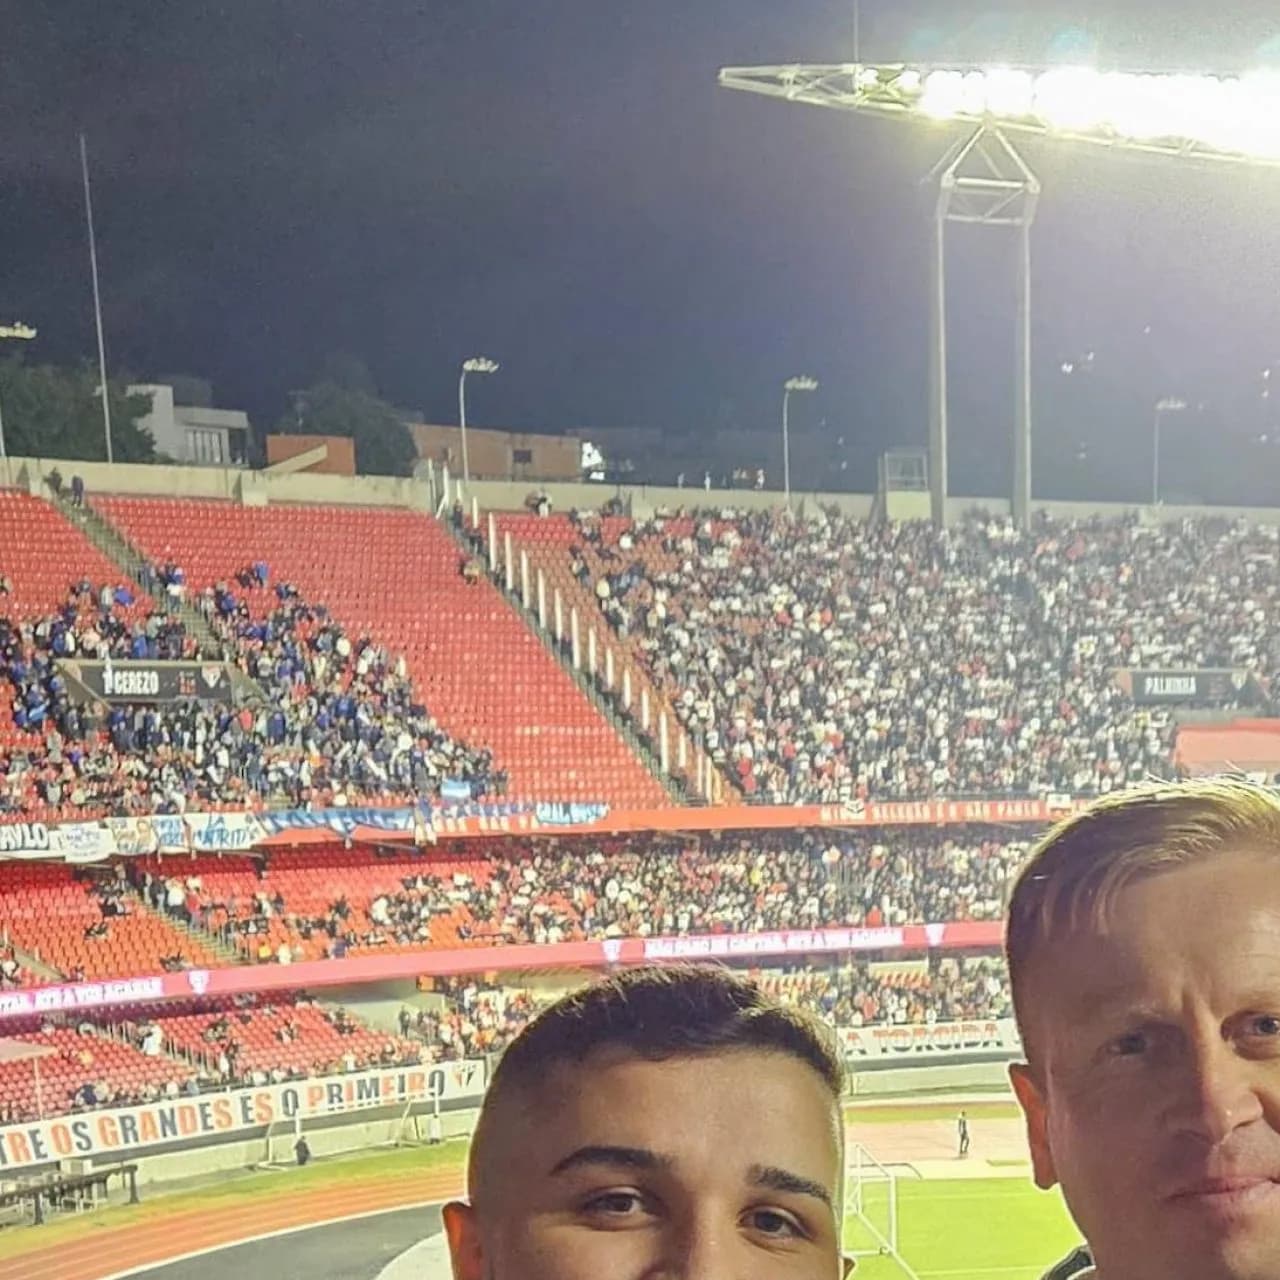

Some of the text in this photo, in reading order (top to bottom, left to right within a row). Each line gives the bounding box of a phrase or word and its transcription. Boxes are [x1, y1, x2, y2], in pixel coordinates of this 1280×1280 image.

[114, 669, 160, 694] CEREZO
[51, 1121, 92, 1154] OS
[98, 1097, 233, 1149] GRANDES
[281, 1088, 300, 1117] O
[306, 1068, 446, 1114] PRIMEIRO
